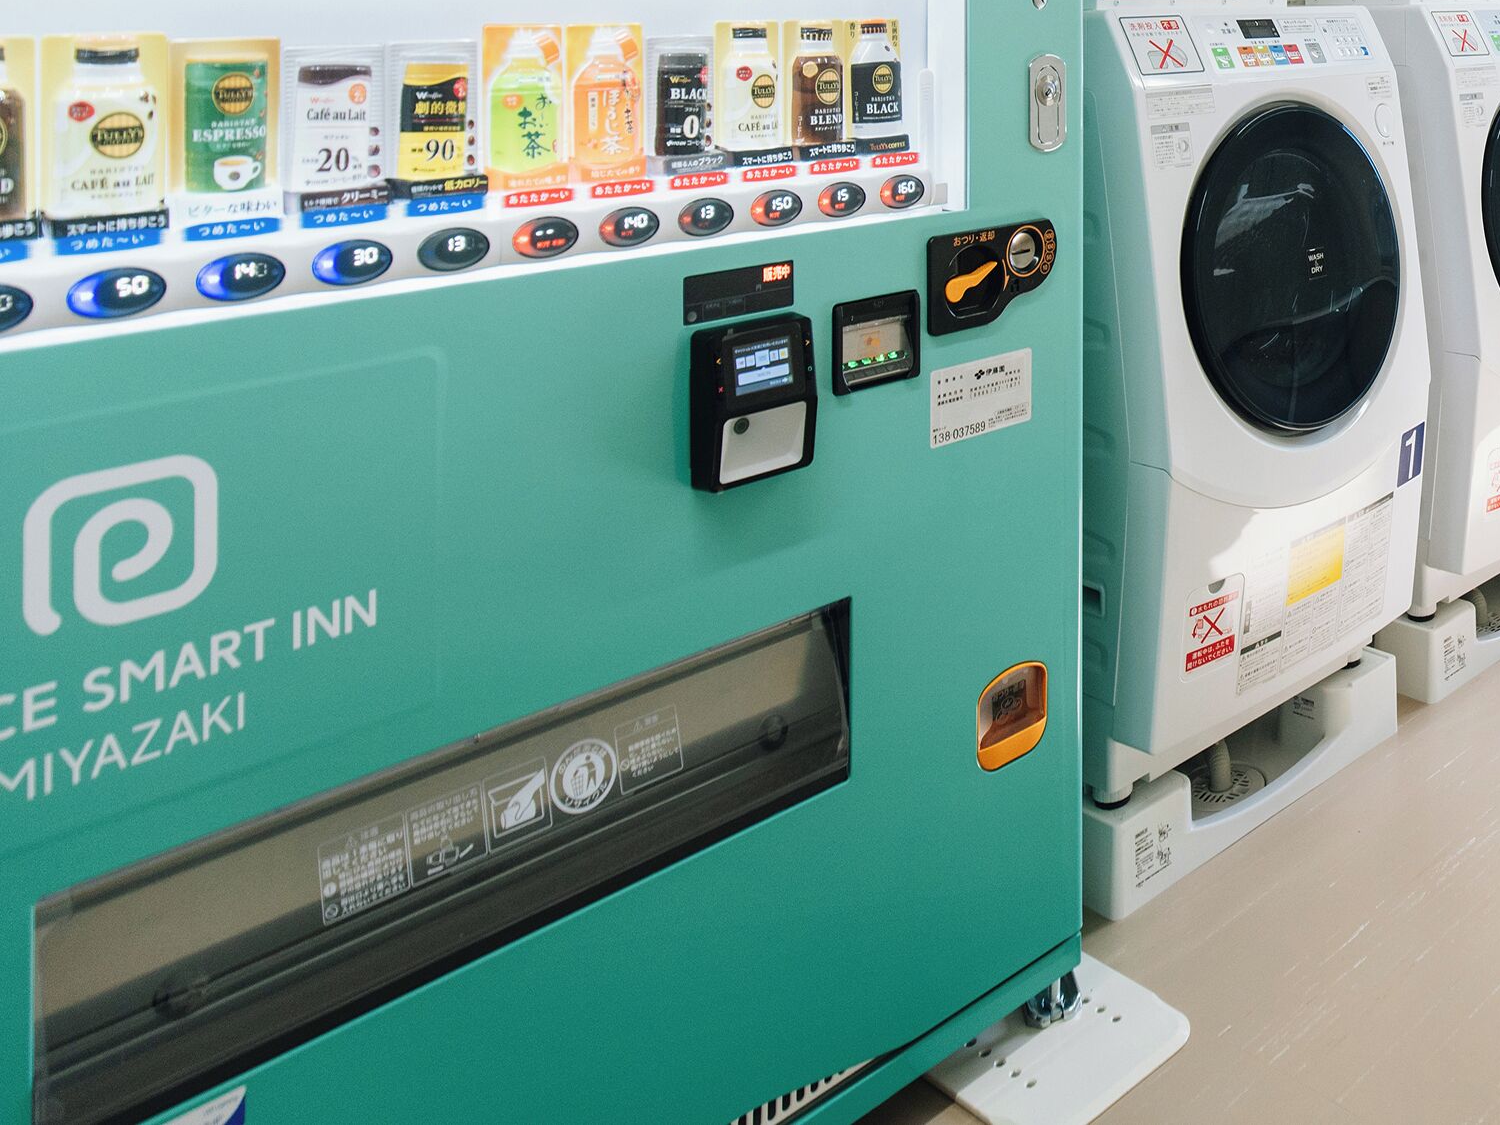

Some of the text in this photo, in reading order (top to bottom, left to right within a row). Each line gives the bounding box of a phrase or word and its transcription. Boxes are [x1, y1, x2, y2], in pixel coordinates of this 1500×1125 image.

[671, 88, 708, 100] BLACK
[307, 108, 366, 121] Café au Lait
[866, 102, 899, 114] BLACK
[738, 121, 761, 132] CAFÉ
[810, 113, 842, 126] BLEND
[192, 125, 265, 142] ESPRESSO
[517, 107, 551, 158] お茶
[683, 115, 700, 139] 0
[425, 138, 455, 161] 90
[809, 142, 856, 157] スマートに持ち歩こう
[316, 147, 350, 173] 20
[742, 149, 793, 166] スマートに持ち歩こう
[875, 154, 915, 165] あたたか～い
[746, 167, 793, 179] あたたか～い
[812, 160, 856, 172] あたたか～い
[72, 177, 130, 190] CAFÉ au
[444, 179, 489, 191] 低カロリー
[674, 175, 724, 186] あたたか～い
[897, 181, 916, 193] 160
[595, 182, 650, 195] あたたか～い
[837, 189, 849, 201] 15
[340, 190, 389, 205] クリーミー
[509, 191, 569, 205] あたたか～い
[771, 197, 793, 211] 150
[417, 199, 472, 213] つめた～い
[701, 205, 715, 219] 13
[313, 210, 374, 223] つめた～い
[624, 213, 648, 229] 140
[67, 213, 166, 236] スマートに持ち歩こう
[199, 222, 265, 236] つめた～い
[71, 234, 144, 251] つめた～い
[953, 231, 996, 247] おつり・返却
[354, 247, 379, 266] 30
[1308, 252, 1324, 262] WASH
[762, 264, 791, 283] 販売中
[1311, 265, 1323, 274] DRY
[116, 275, 149, 297] 50
[932, 421, 986, 445] 138 037589
[1405, 430, 1417, 480] 1
[82, 588, 377, 712] SMART INN
[0, 691, 246, 802] MIYAZAKI
